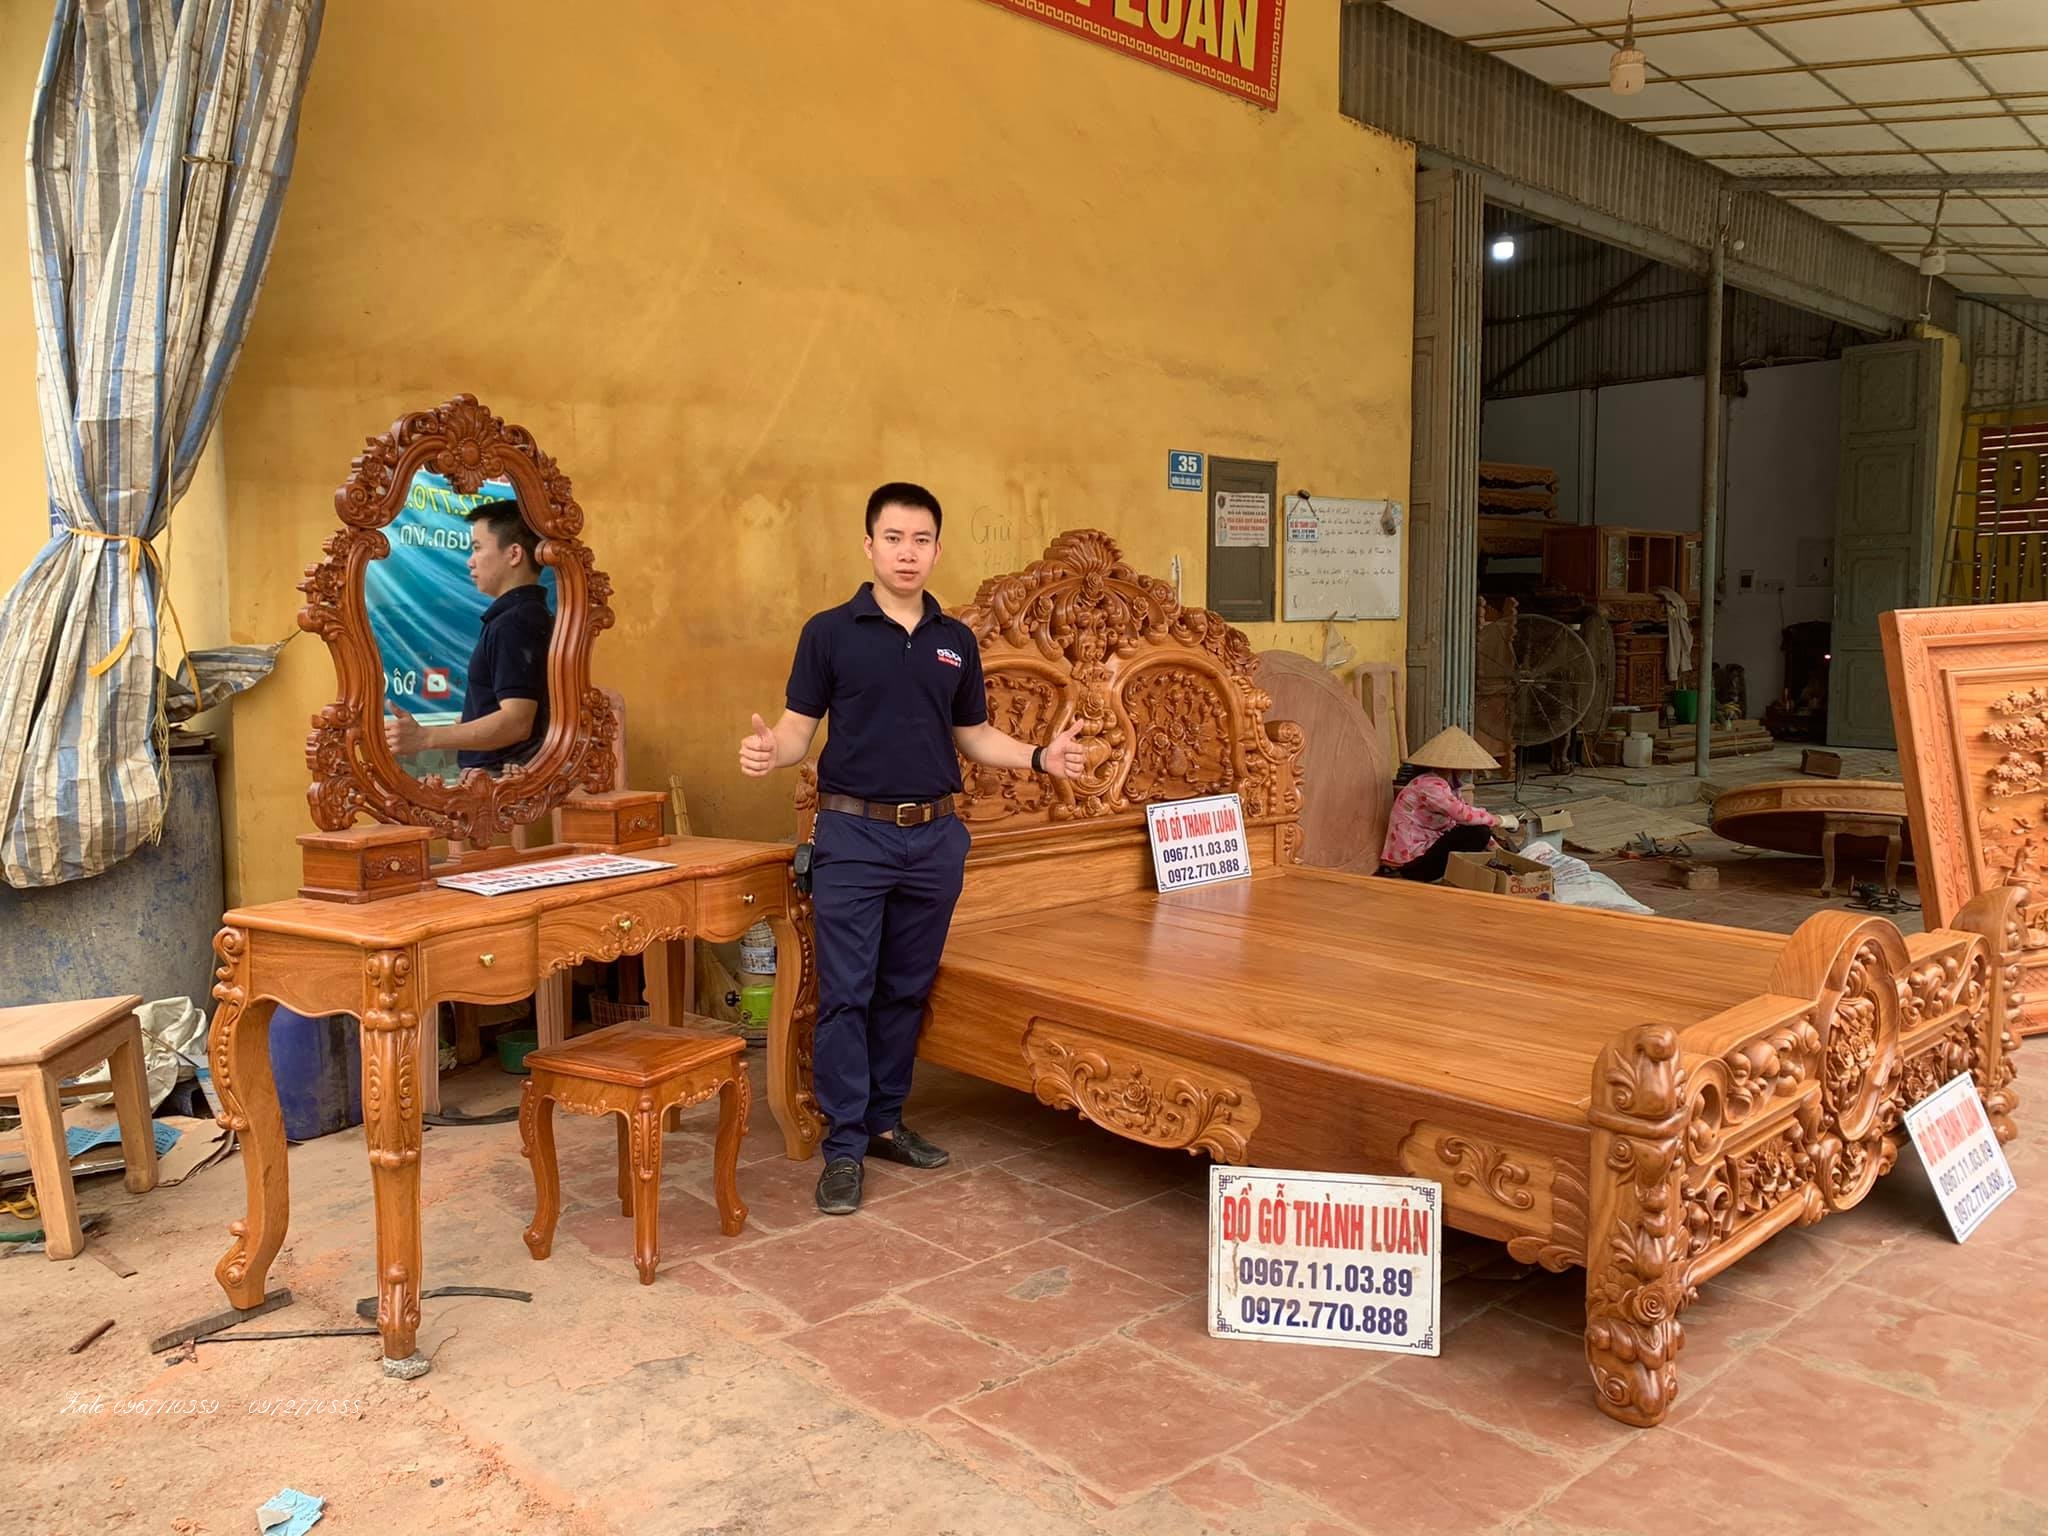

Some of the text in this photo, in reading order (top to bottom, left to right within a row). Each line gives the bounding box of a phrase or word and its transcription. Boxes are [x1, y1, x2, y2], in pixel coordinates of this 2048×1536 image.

[1178, 455, 1197, 473] 35
[1163, 838, 1238, 863] 0967.11.03.89
[1168, 858, 1240, 883] 0972.770.888
[1223, 1183, 1429, 1256] ĐỒ GỖ THÀNH LUÂN
[1239, 1256, 1413, 1297] 0967.11.03.89
[1241, 1295, 1408, 1336] 0972.770.888
